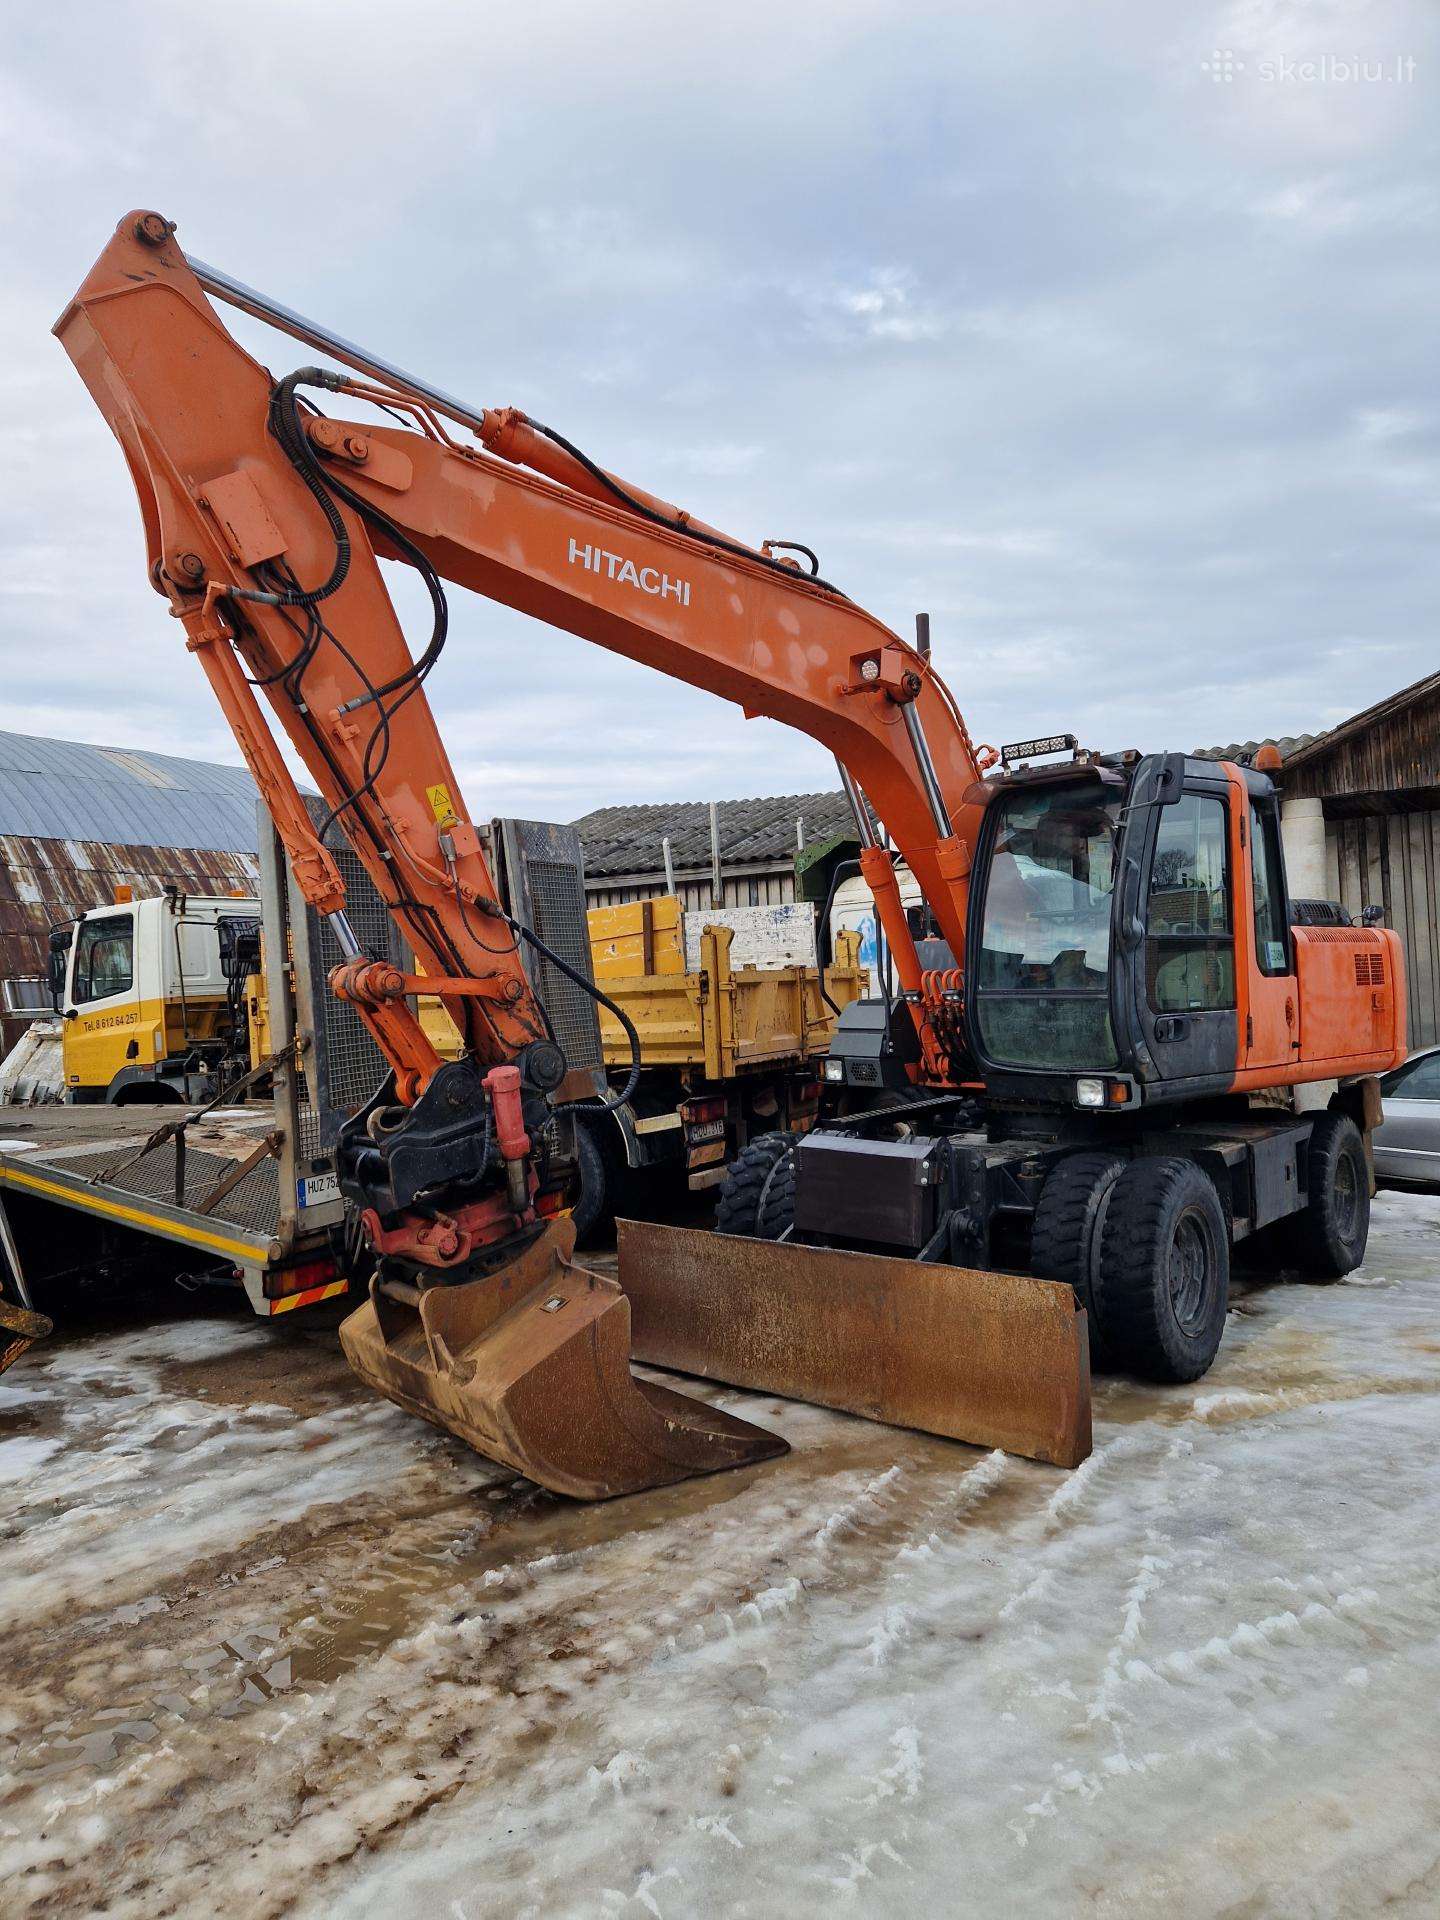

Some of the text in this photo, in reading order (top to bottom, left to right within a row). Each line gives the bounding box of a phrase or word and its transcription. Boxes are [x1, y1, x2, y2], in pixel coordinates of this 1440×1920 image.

[568, 537, 691, 607] HITACHI
[102, 1018, 114, 1029] 612
[115, 1016, 124, 1026] 64
[126, 1013, 138, 1024] 257
[308, 1179, 325, 1194] HUZ
